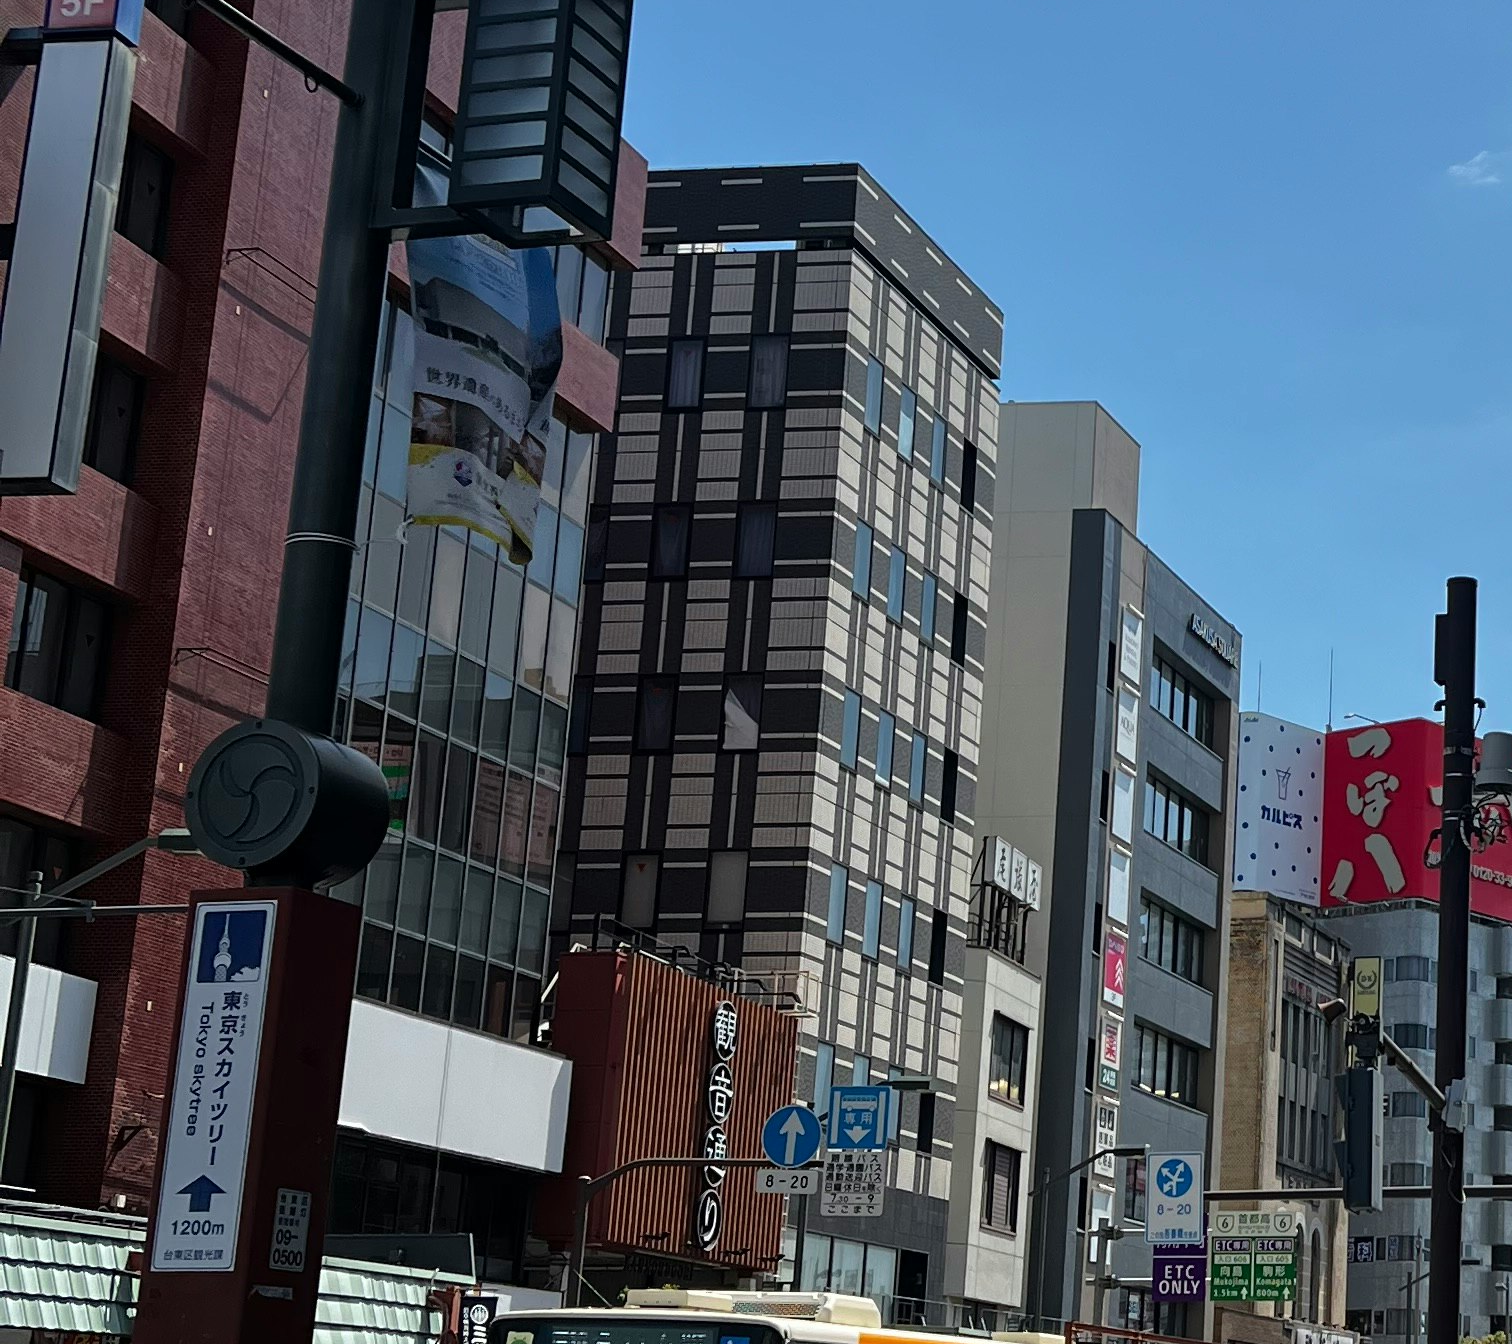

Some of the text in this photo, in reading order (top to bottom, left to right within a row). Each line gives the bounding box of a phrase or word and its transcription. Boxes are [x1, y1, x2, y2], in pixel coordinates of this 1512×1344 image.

[1260, 804, 1303, 831] カルピス
[1328, 726, 1406, 897] つぼ八
[195, 1001, 215, 1058] Tokyo
[208, 990, 243, 1166] 東京スカイツリー
[843, 1111, 873, 1125] 専用
[827, 1205, 876, 1214] ここまで
[170, 1219, 225, 1236] 1200m
[1221, 1217, 1229, 1229] 6
[1279, 1217, 1287, 1229] 6
[272, 1248, 303, 1267] 0500
[1164, 1264, 1195, 1280] ETC
[1220, 1265, 1243, 1277] 向島
[1158, 1279, 1201, 1295] ONLY
[1213, 1277, 1249, 1287] Mukojima
[1256, 1277, 1292, 1287] Komagata
